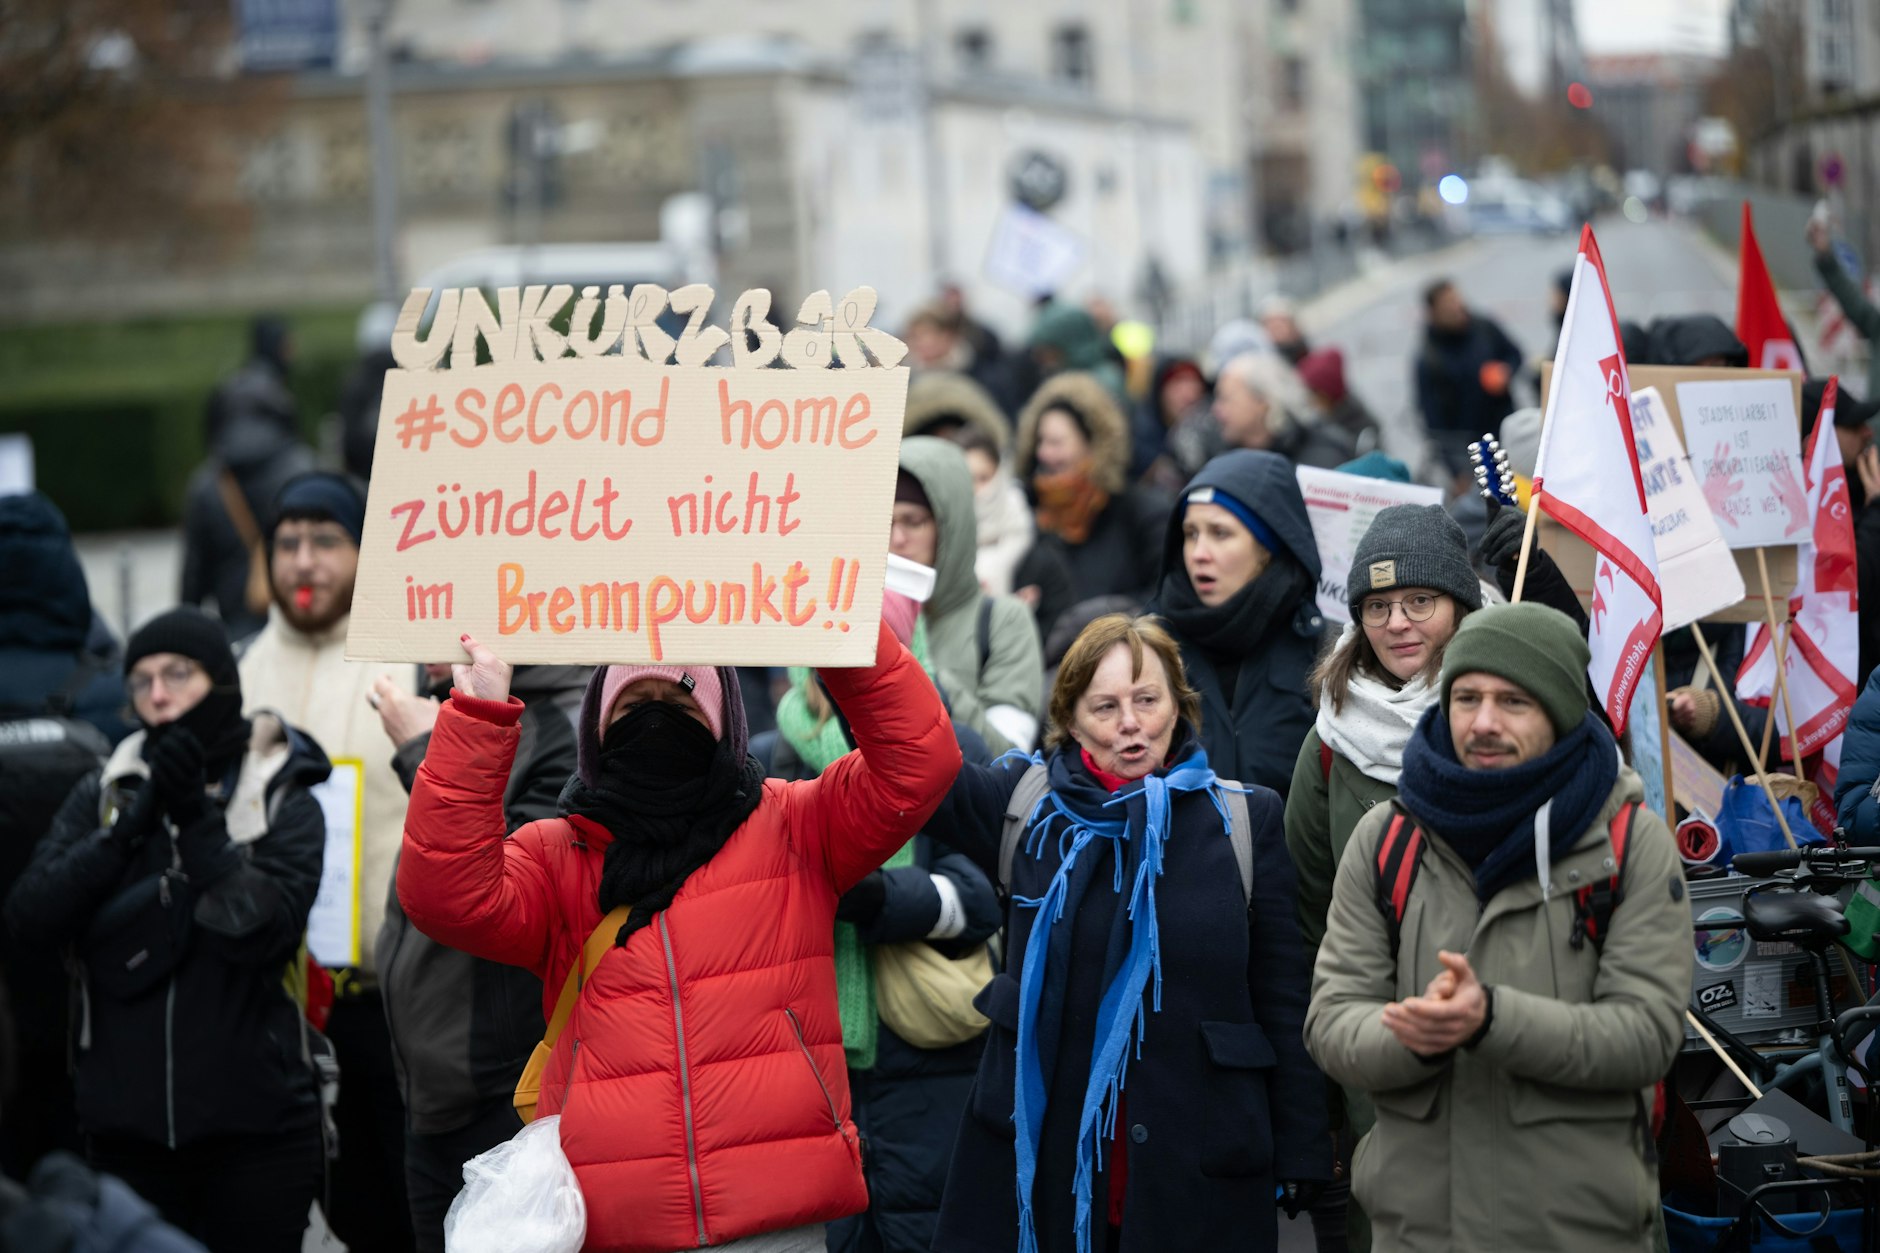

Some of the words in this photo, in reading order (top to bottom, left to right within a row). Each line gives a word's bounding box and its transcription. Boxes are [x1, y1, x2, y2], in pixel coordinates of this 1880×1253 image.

[395, 376, 669, 451] #second
[718, 379, 878, 450] home
[390, 470, 632, 552] zündelt
[667, 472, 801, 536] nicht
[405, 576, 453, 621] im
[498, 557, 860, 661] Brennpunkt!!
